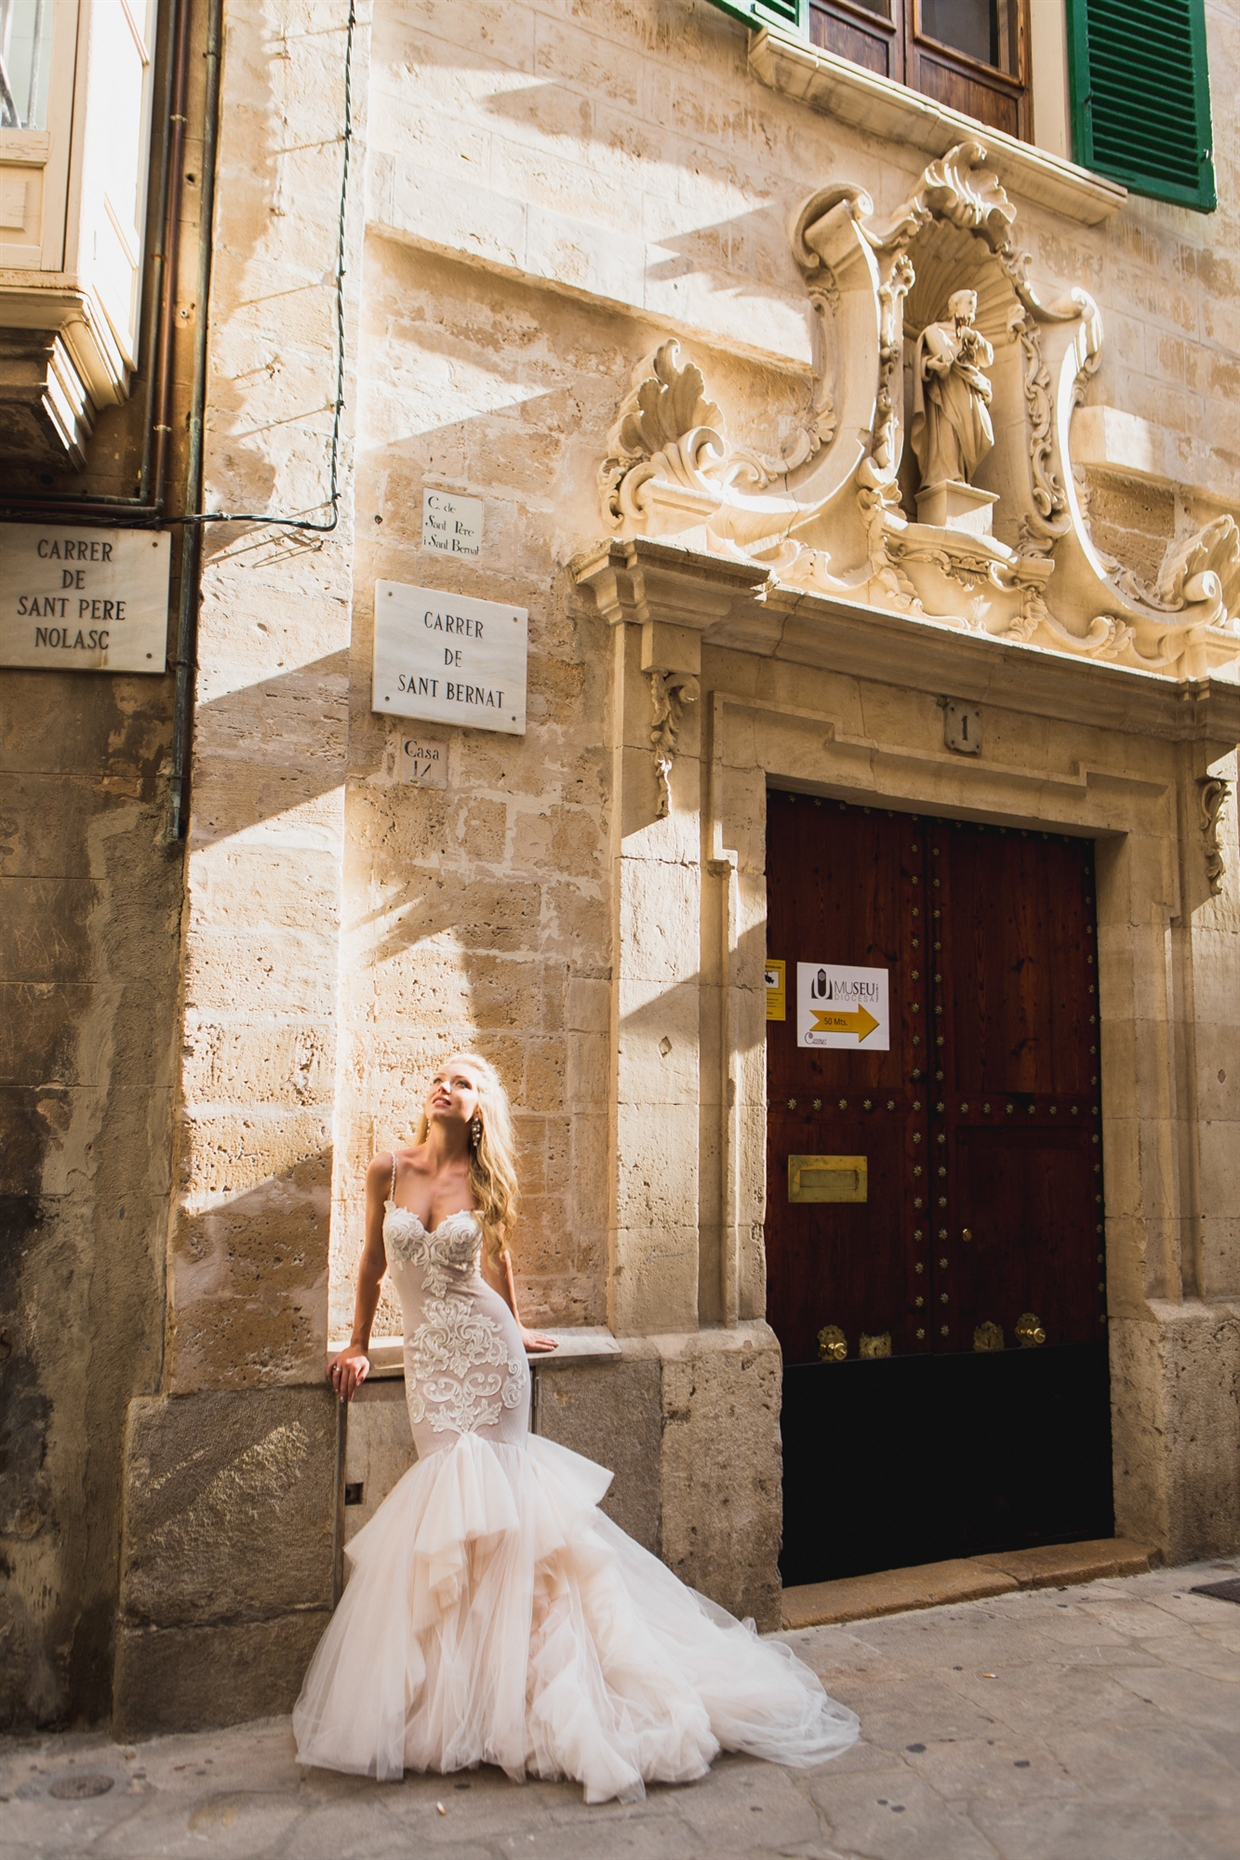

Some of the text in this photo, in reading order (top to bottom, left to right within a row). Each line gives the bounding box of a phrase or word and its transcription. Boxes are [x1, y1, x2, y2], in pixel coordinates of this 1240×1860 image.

[428, 496, 456, 513] C. de
[425, 514, 474, 537] Sant Pere
[37, 539, 112, 562] CARRER
[423, 533, 479, 555] i Sant Bernat
[61, 569, 86, 590] DE
[17, 596, 127, 621] SANT PERE
[424, 610, 485, 640] CARRER
[34, 627, 110, 650] NOLASC
[443, 647, 463, 668] DE
[397, 674, 506, 709] SANT BERNAT
[961, 715, 968, 741] 1
[404, 739, 440, 761] Casa
[834, 980, 875, 996] MUSEU
[824, 1017, 848, 1027] 50 Mts.
